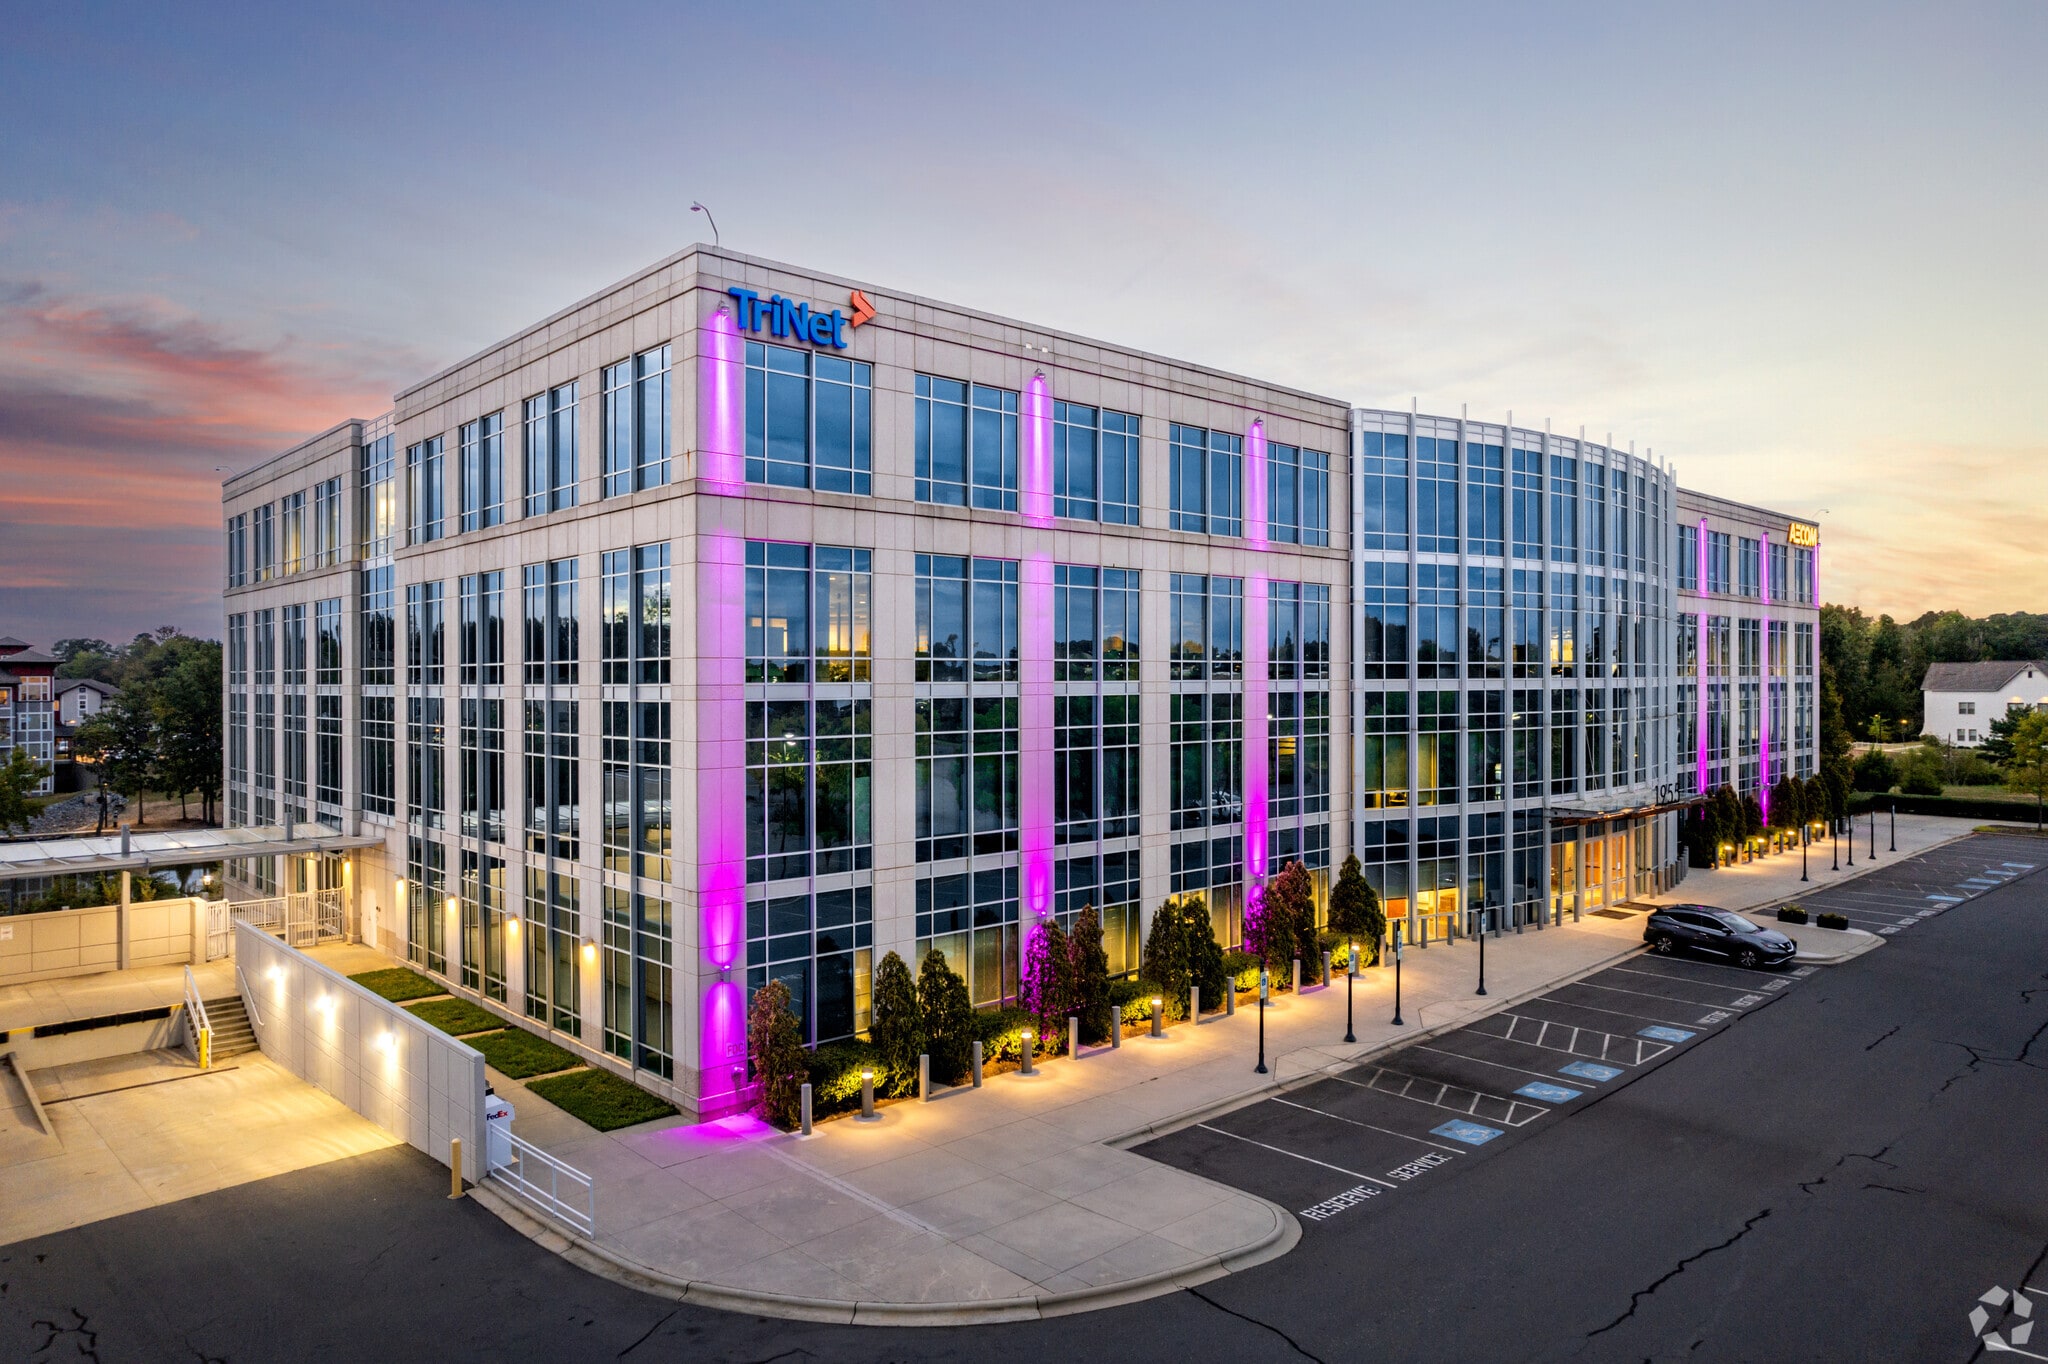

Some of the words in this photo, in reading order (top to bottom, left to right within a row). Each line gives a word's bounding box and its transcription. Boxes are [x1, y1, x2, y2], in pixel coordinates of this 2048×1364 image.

[728, 286, 847, 349] TriNet
[1788, 522, 1818, 547] AECOM
[1655, 783, 1680, 806] 1955
[486, 1110, 508, 1121] FedEx
[1386, 1152, 1453, 1180] SERVICE
